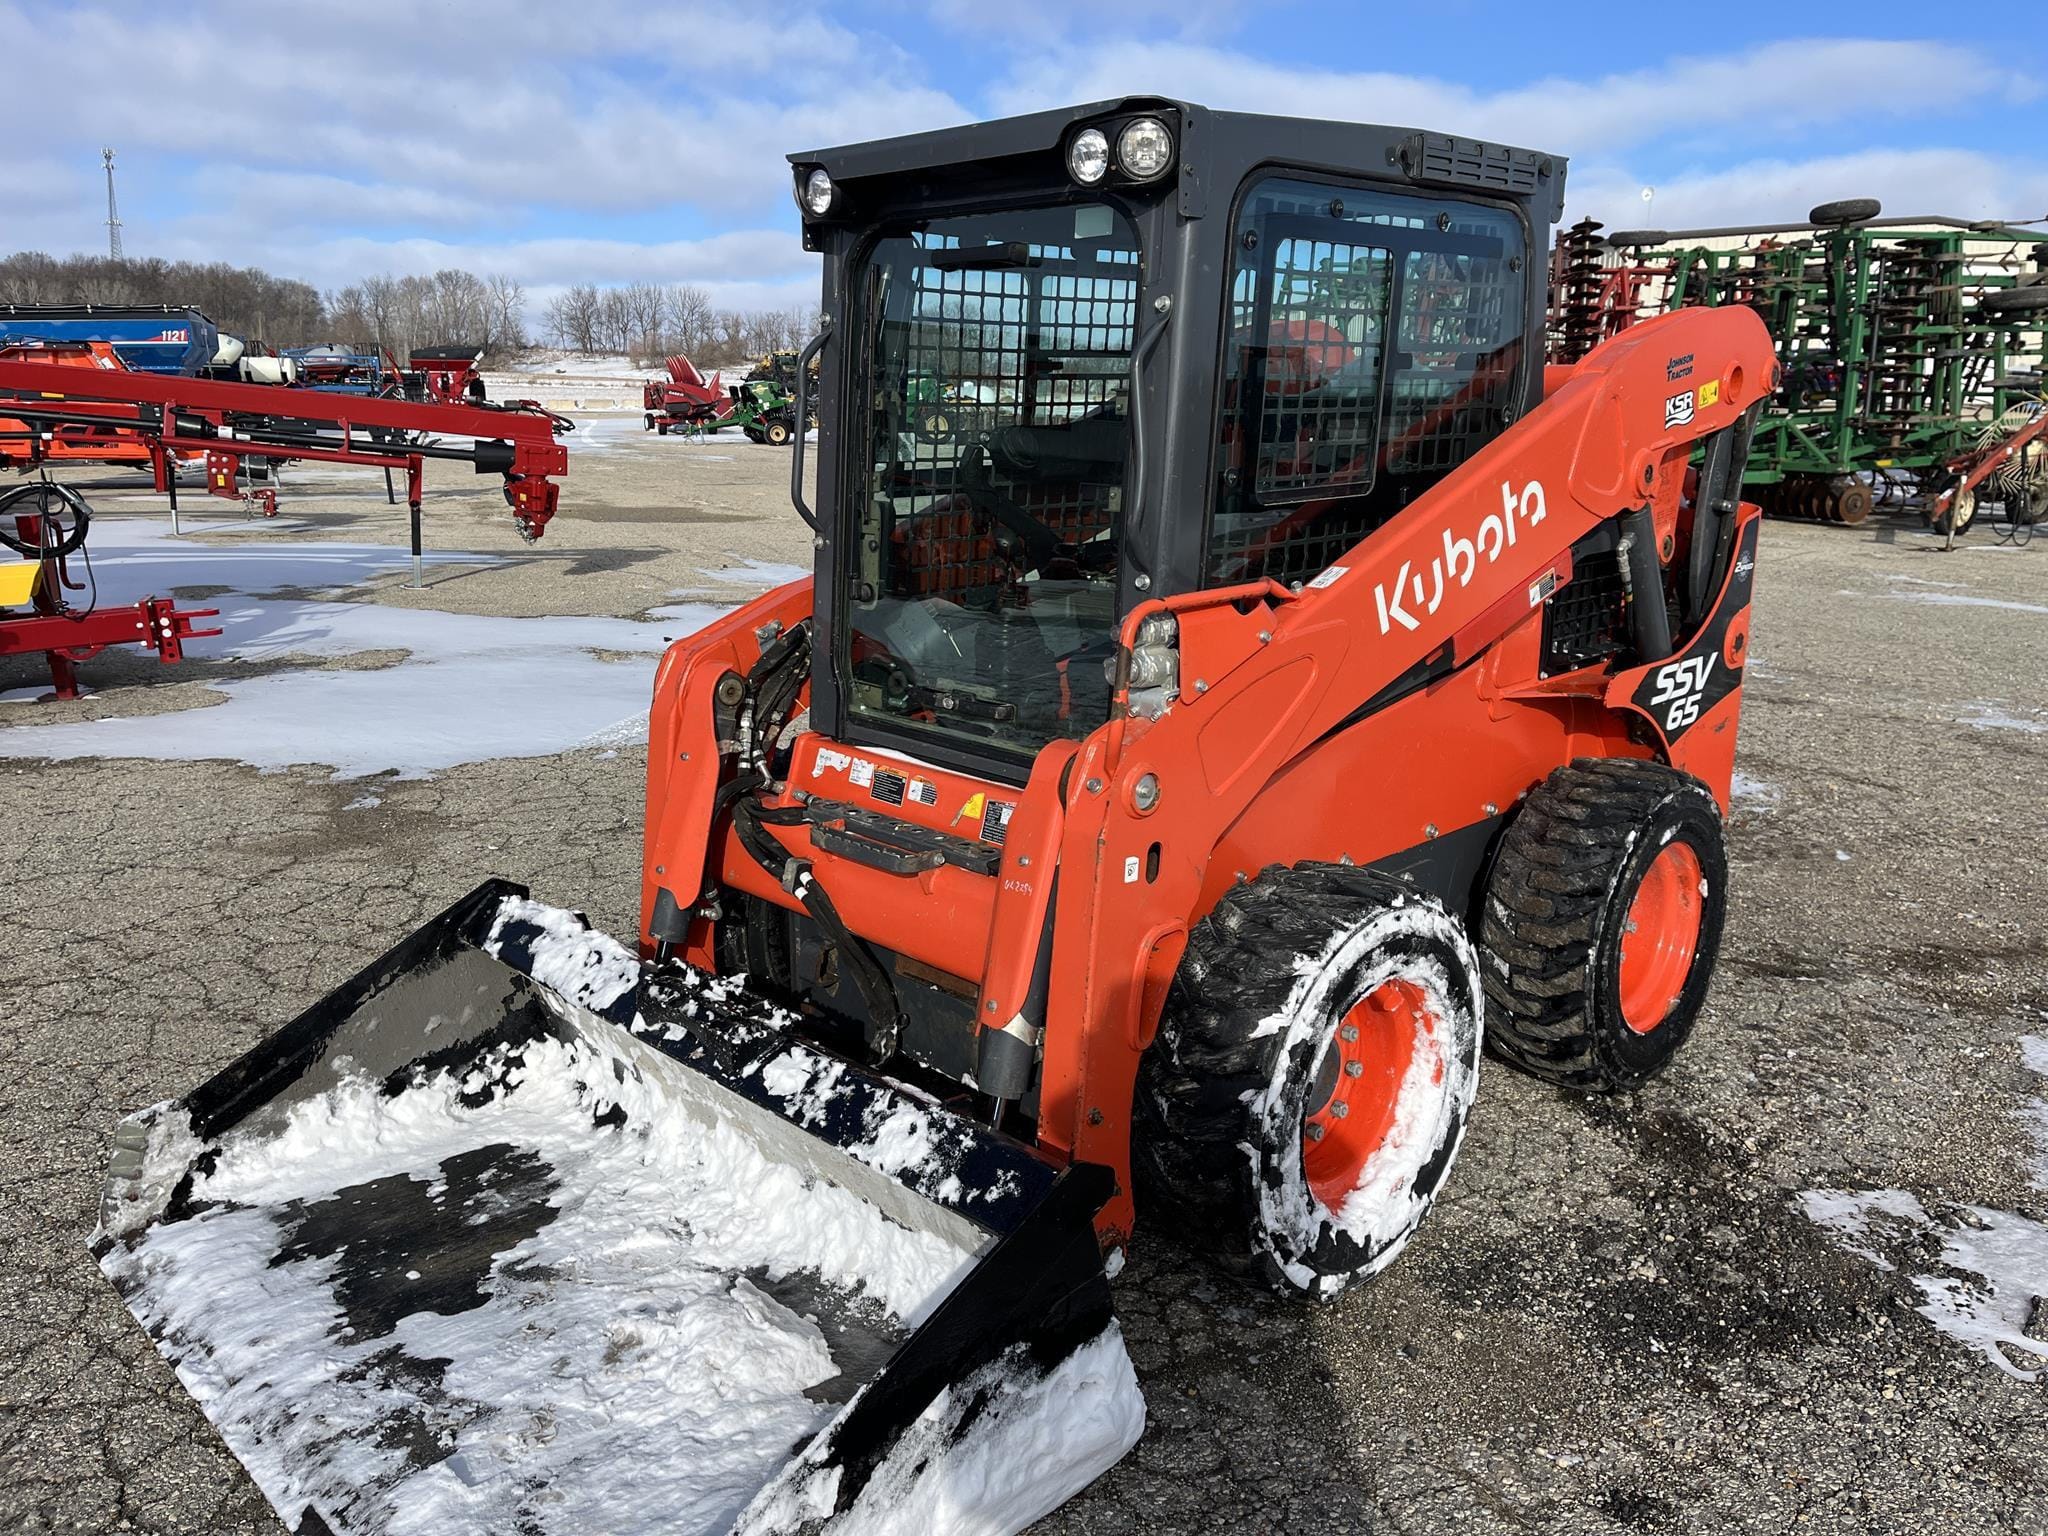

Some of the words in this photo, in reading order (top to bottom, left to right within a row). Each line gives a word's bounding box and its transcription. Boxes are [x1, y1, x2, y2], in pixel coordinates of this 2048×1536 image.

[161, 330, 185, 341] 1121
[1667, 354, 1694, 369] JOHNSON
[1667, 366, 1693, 381] TRACTOR
[1665, 391, 1693, 417] KSR
[1374, 480, 1547, 635] Kubota
[1650, 651, 1719, 706] SSV
[1666, 692, 1702, 731] 65
